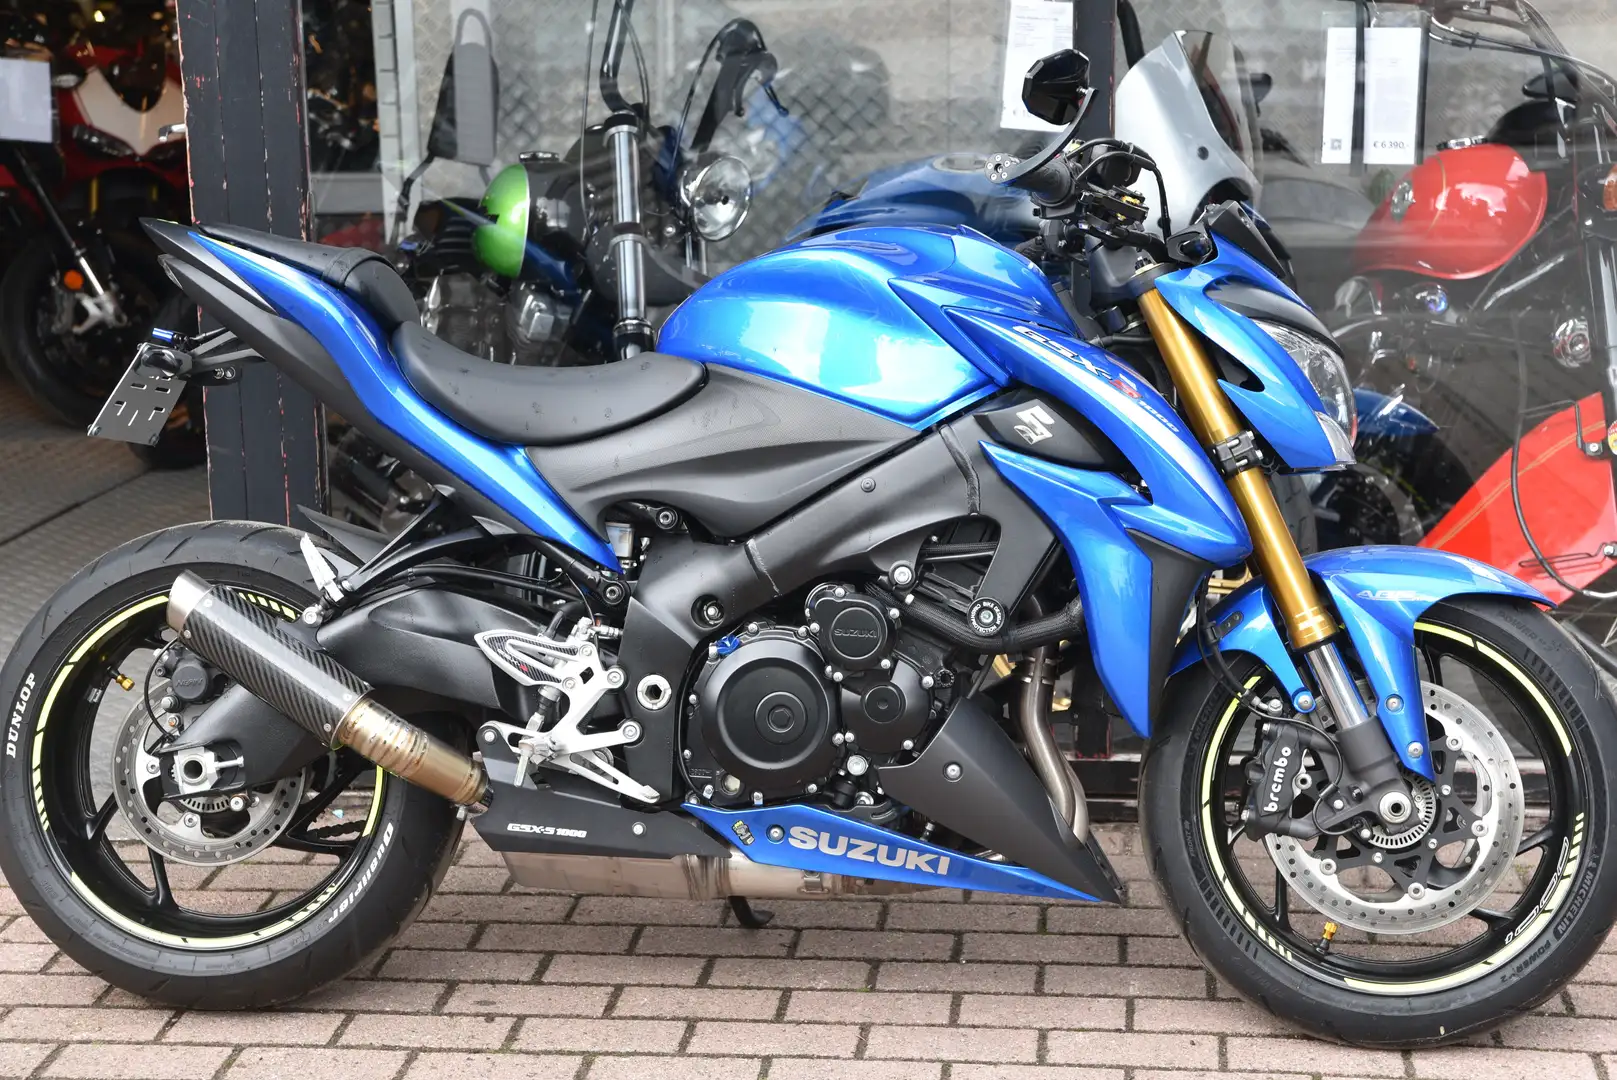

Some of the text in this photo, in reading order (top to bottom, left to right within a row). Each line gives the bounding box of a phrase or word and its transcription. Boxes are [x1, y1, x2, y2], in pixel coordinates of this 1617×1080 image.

[833, 628, 878, 638] SUZUKI
[5, 672, 36, 759] DUNLOP
[1263, 746, 1292, 812] brembo
[506, 823, 588, 838] GSX-S 1000
[788, 826, 951, 876] SUZUKI
[328, 822, 394, 923] Qualifier
[1557, 871, 1595, 935] MICHELIN
[1516, 939, 1552, 973] POWER
